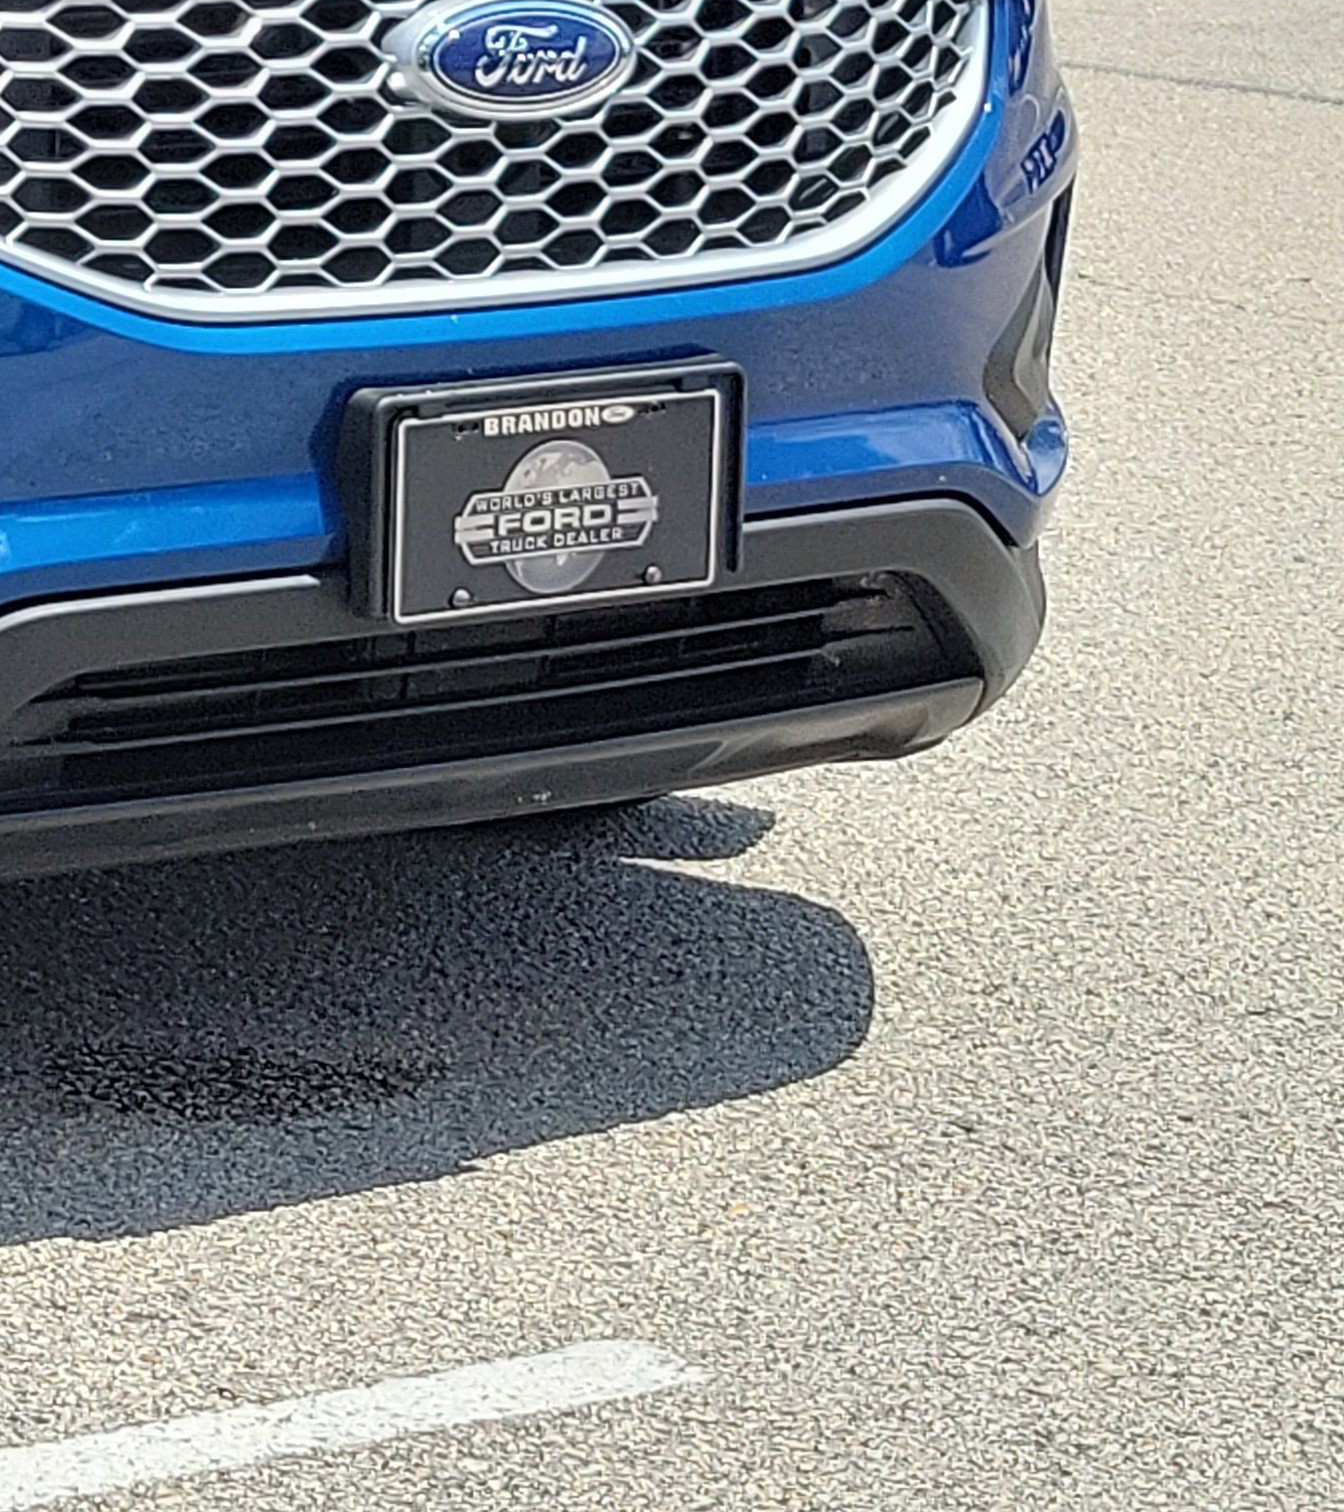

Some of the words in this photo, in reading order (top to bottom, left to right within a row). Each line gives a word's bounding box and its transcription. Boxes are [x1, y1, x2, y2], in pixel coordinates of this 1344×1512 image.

[474, 24, 590, 88] Ford
[483, 406, 601, 437] BRANDON
[475, 491, 553, 513] WORLD'S
[558, 482, 640, 504] LARGEST
[497, 503, 612, 537] FORD
[489, 536, 548, 554] TRUCK
[553, 527, 624, 547] DEALER
